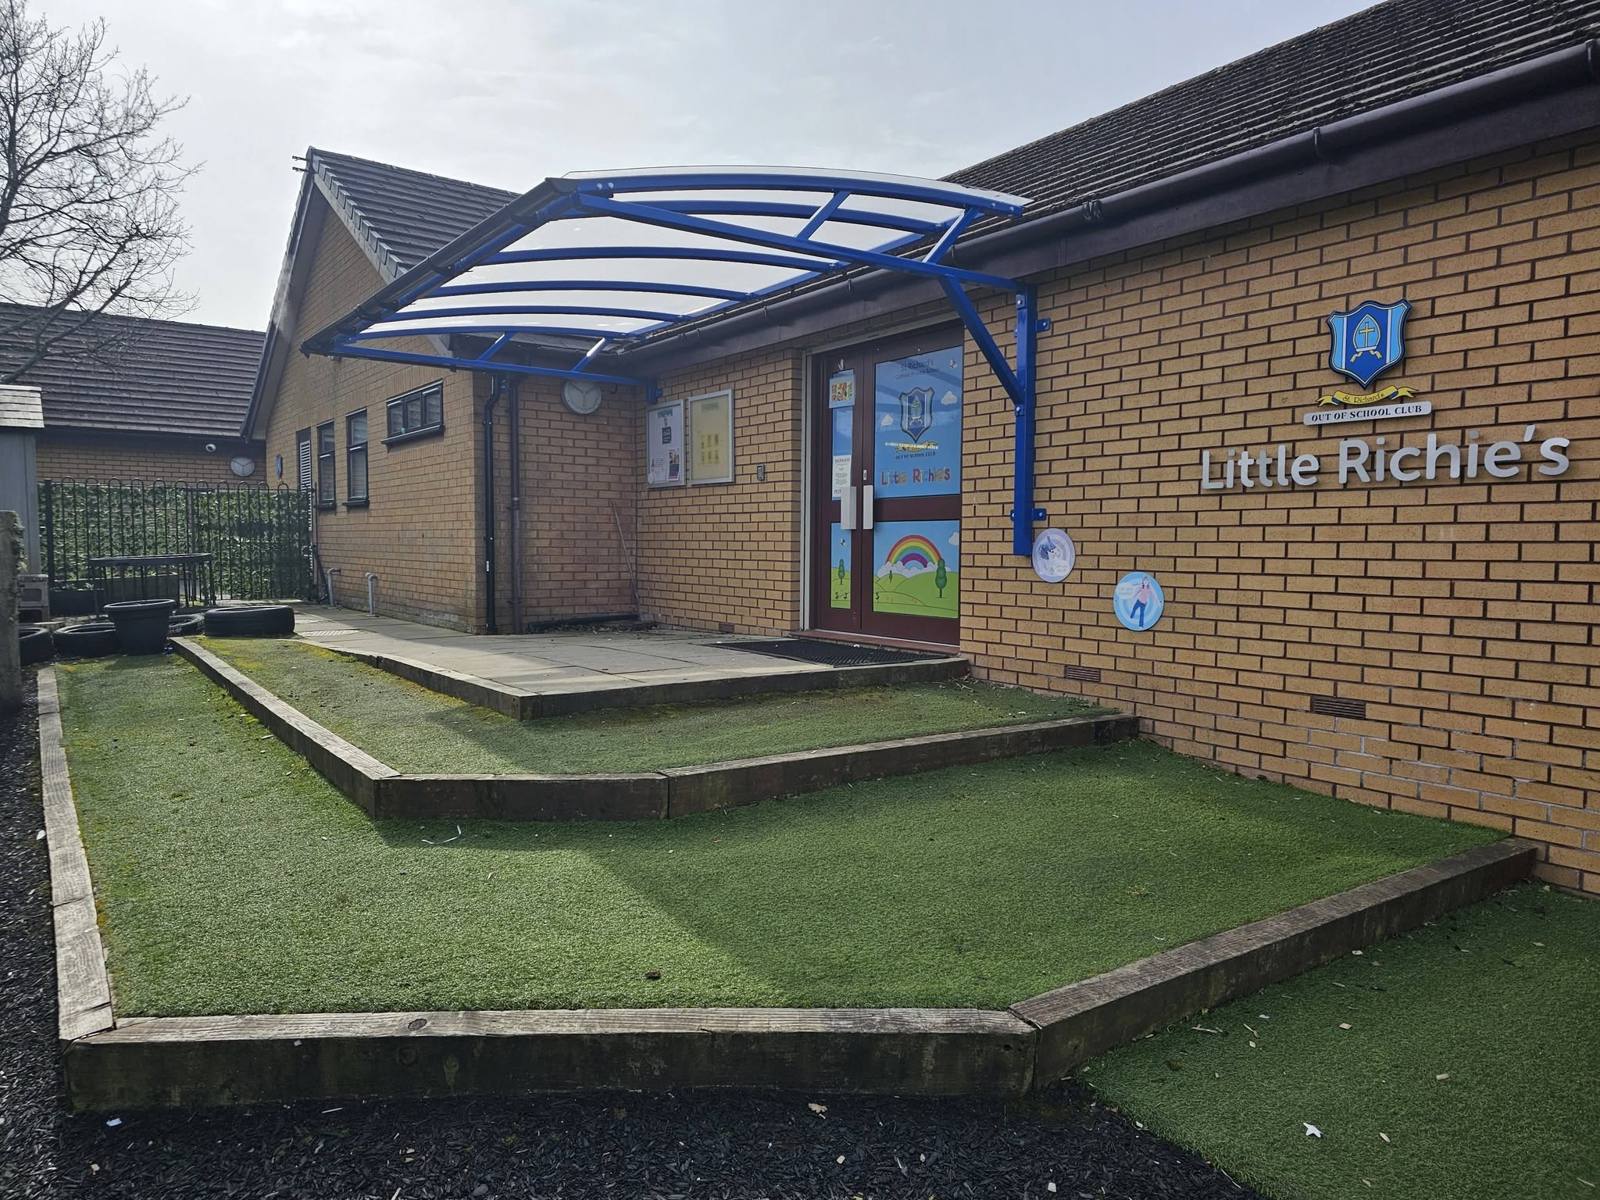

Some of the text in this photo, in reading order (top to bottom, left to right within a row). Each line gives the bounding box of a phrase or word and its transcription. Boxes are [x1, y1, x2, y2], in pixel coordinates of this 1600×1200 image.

[1311, 405, 1422, 422] OUT OF SCHOOL CLUB
[1201, 424, 1570, 489] Little Richie's
